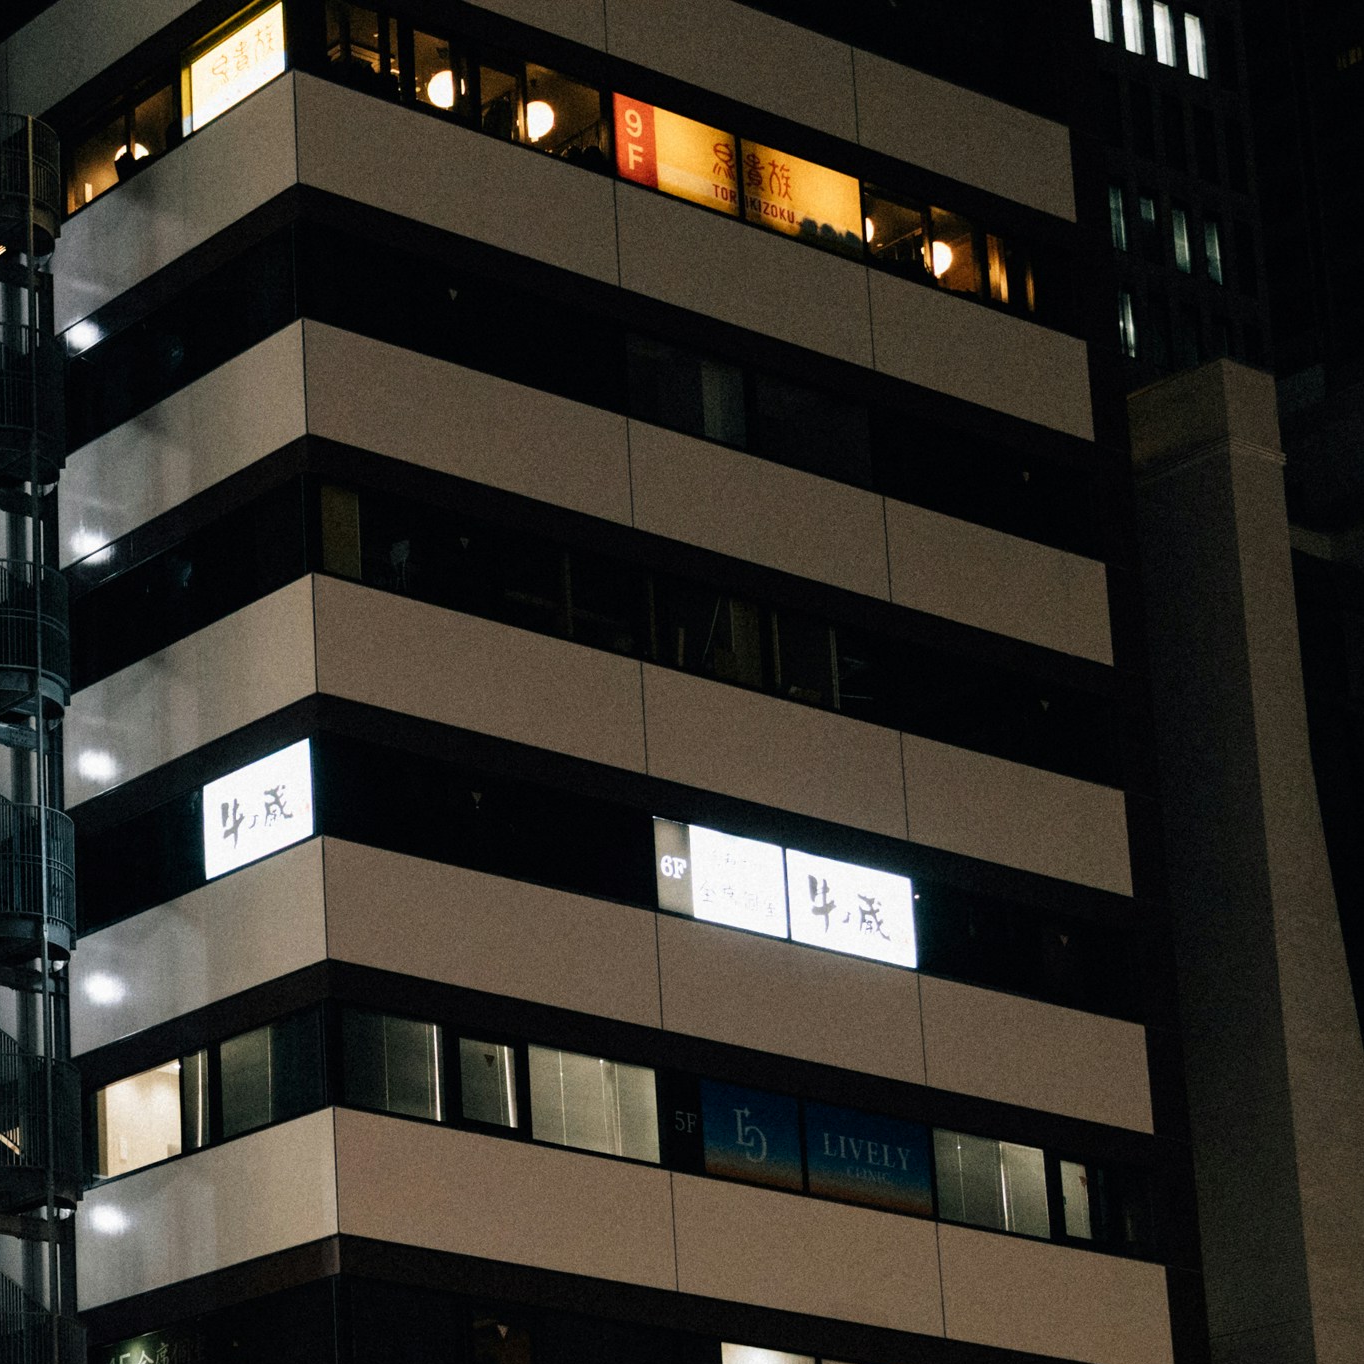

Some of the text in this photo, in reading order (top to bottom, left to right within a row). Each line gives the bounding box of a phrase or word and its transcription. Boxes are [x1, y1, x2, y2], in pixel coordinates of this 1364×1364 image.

[624, 108, 644, 171] 9F
[660, 855, 687, 879] 6F
[674, 1110, 698, 1134] 5F
[823, 1132, 912, 1172] LIVELY
